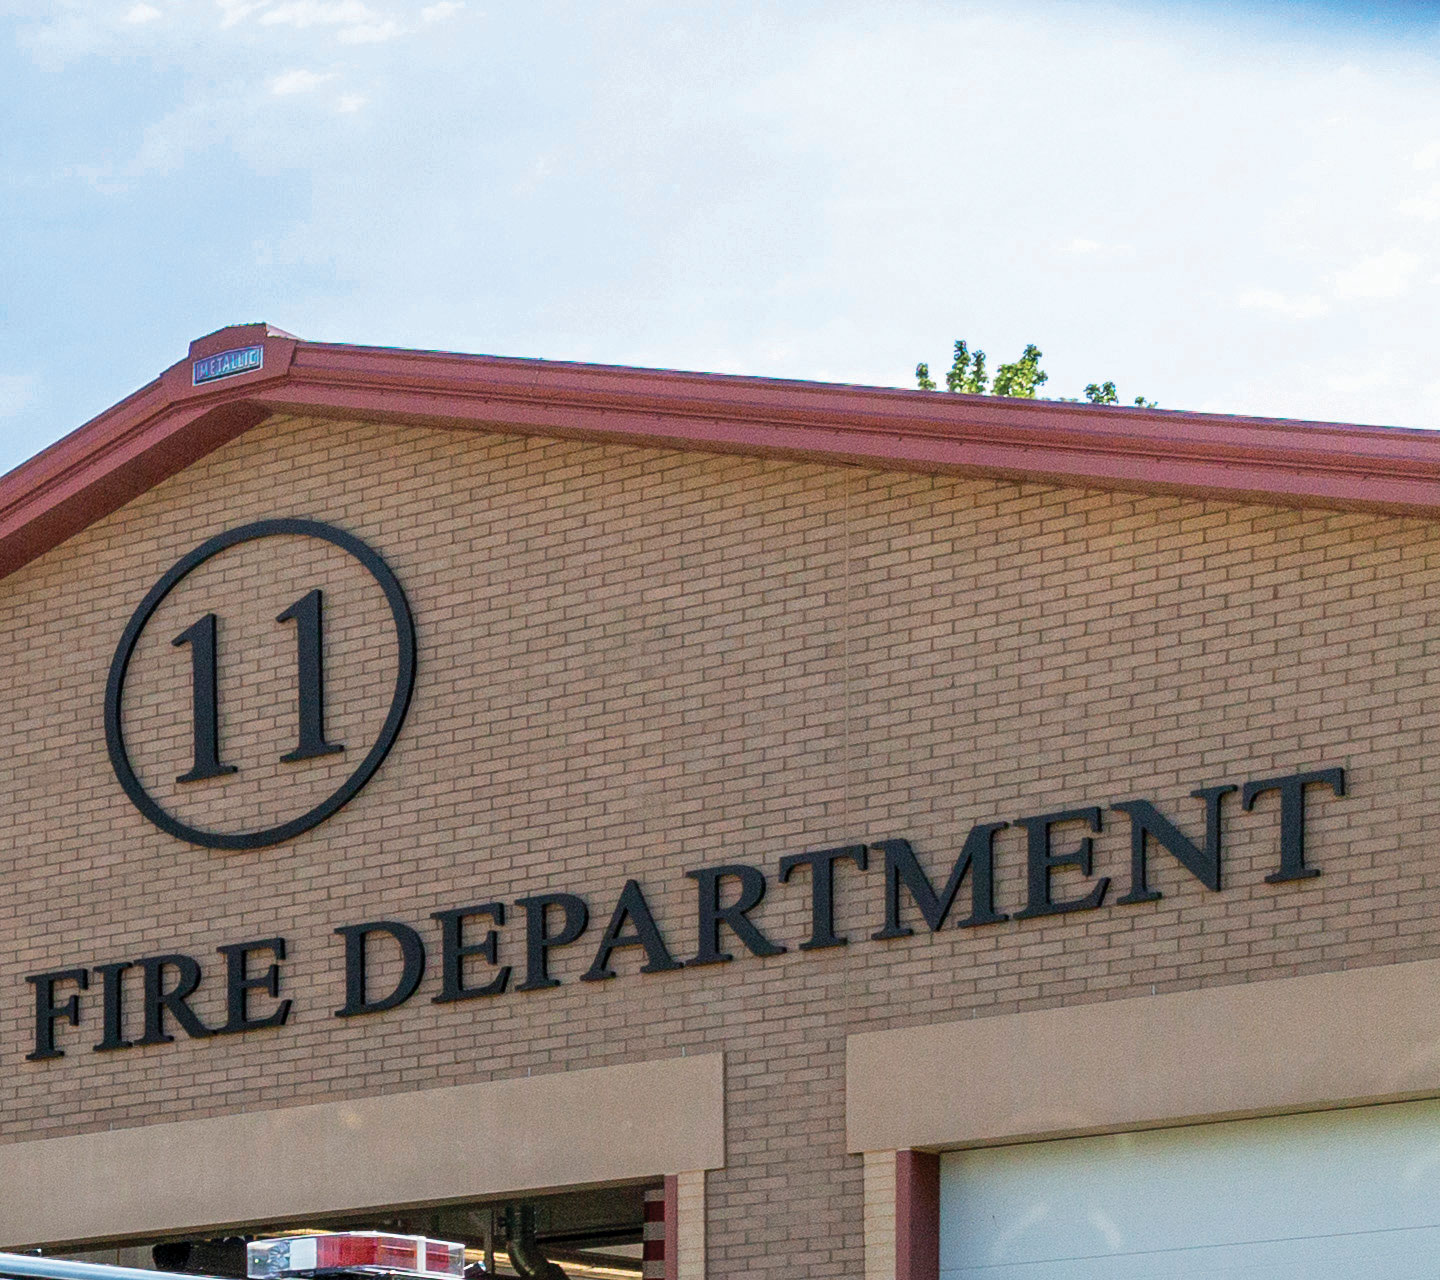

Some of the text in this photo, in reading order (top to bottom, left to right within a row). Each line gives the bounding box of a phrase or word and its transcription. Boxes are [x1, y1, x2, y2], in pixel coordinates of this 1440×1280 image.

[172, 589, 348, 784] 11
[25, 936, 293, 1063] FIRE
[333, 767, 1348, 1020] DEPARTMENT
